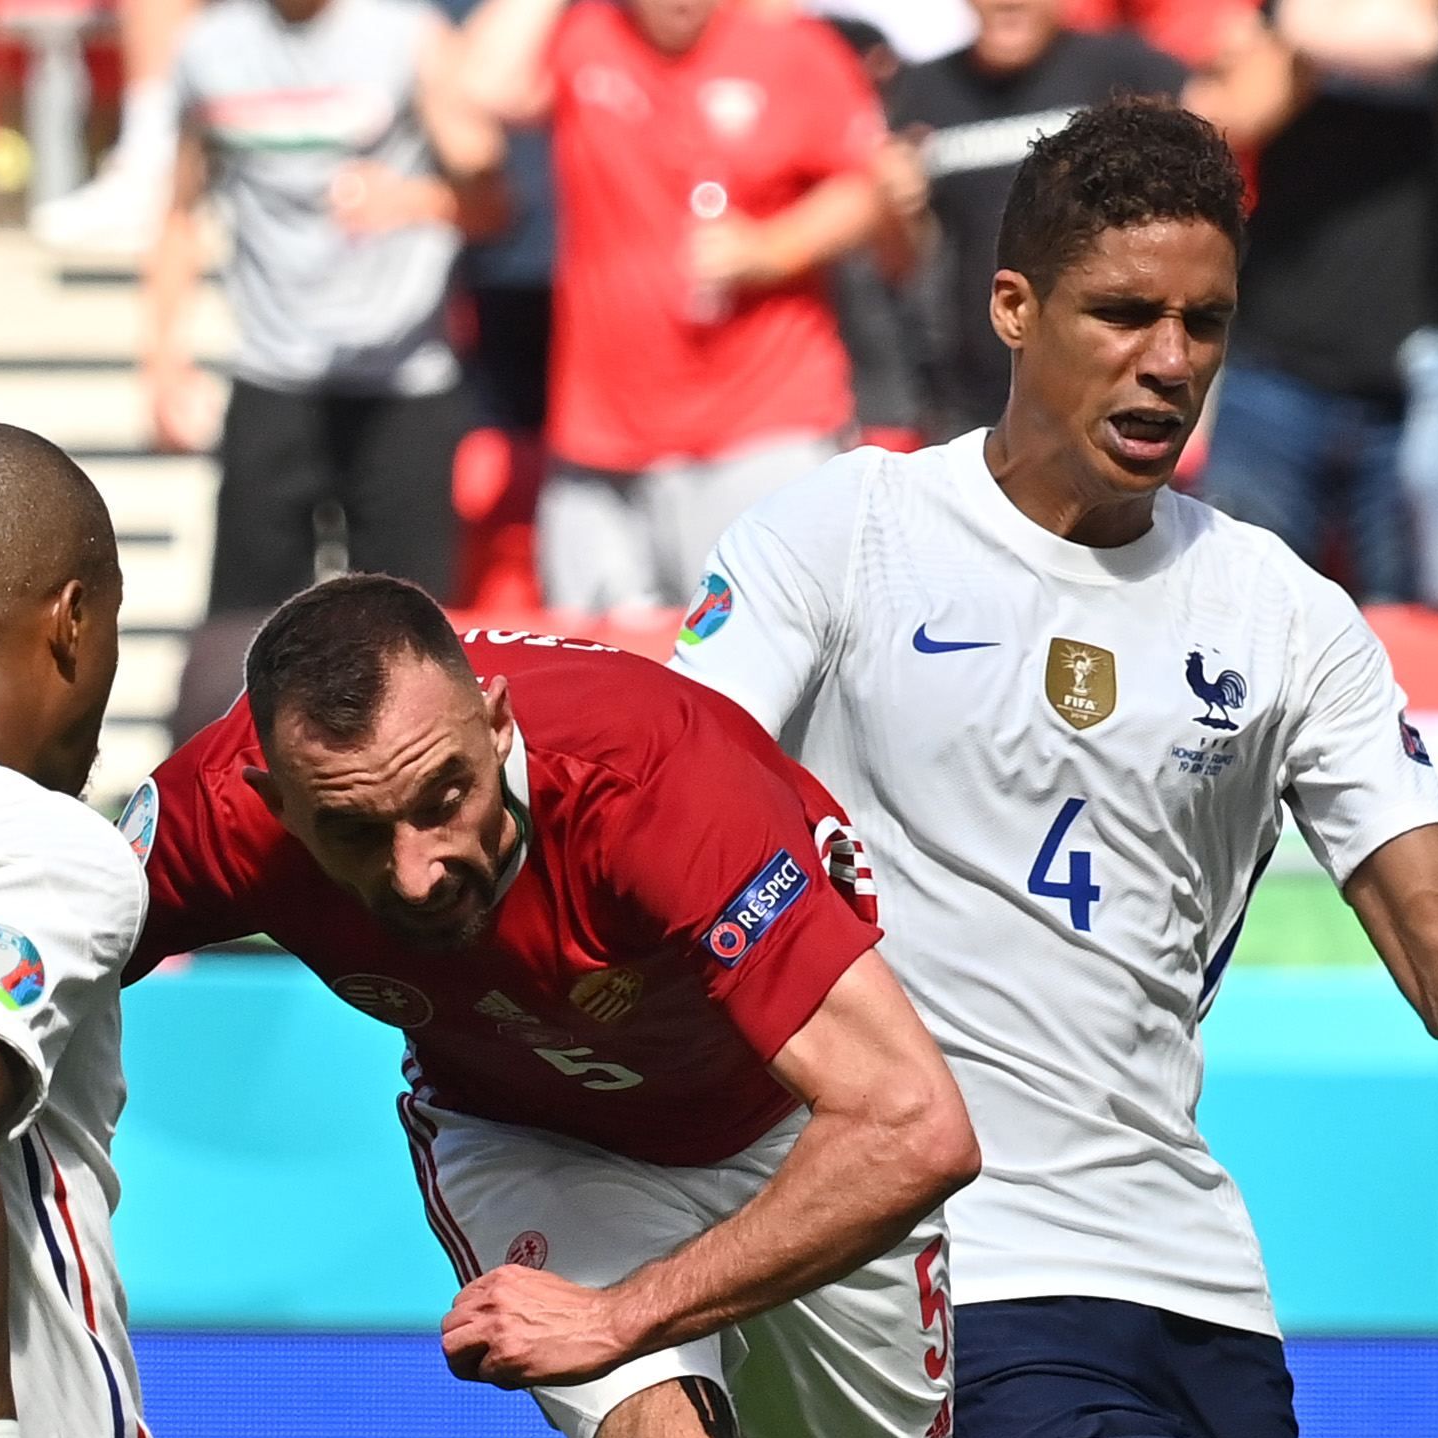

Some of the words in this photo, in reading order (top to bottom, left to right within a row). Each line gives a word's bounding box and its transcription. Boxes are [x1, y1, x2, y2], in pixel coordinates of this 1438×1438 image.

[1064, 694, 1095, 711] FIFA
[737, 857, 800, 930] RESPECT
[1027, 797, 1100, 932] 4
[532, 1047, 644, 1091] 5
[914, 1233, 949, 1380] 5
